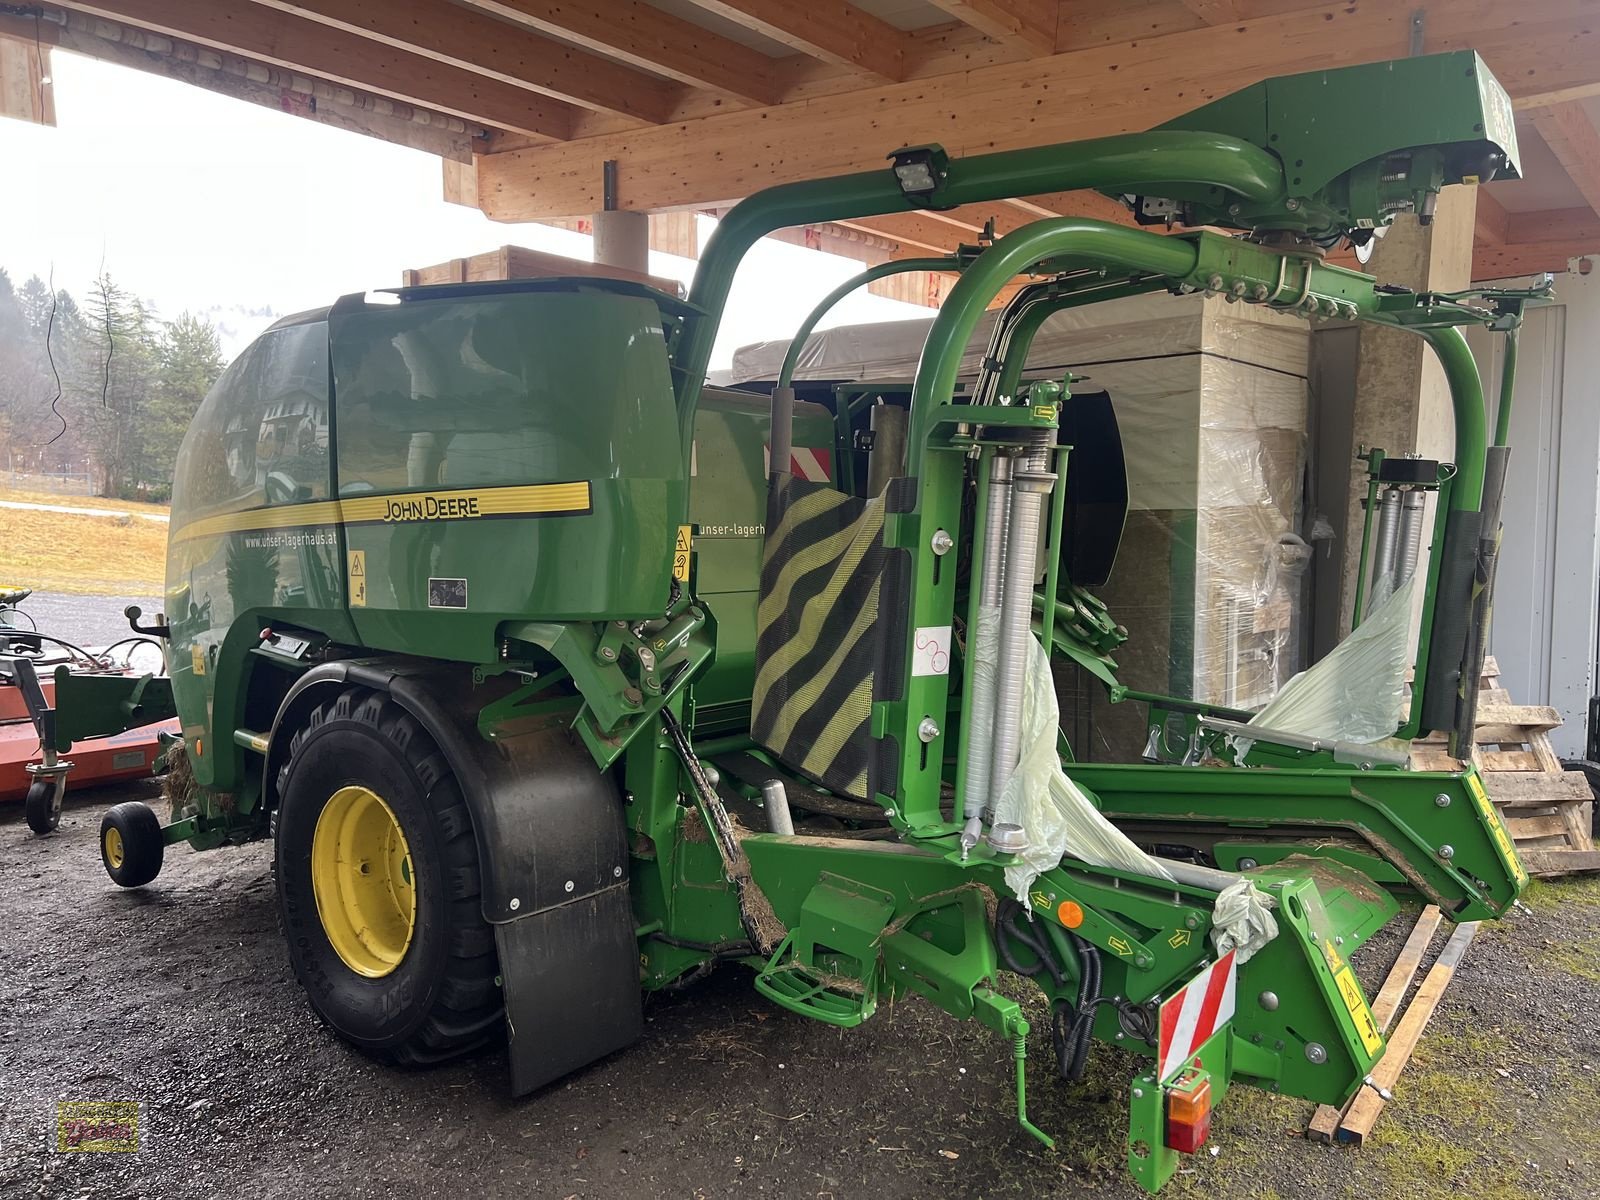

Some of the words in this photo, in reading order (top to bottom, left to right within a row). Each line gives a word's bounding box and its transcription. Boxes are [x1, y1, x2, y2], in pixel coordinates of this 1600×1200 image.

[383, 499, 423, 520] JOHN
[425, 496, 480, 517] DEERE
[245, 531, 337, 549] www.unser-lagerhaus.at
